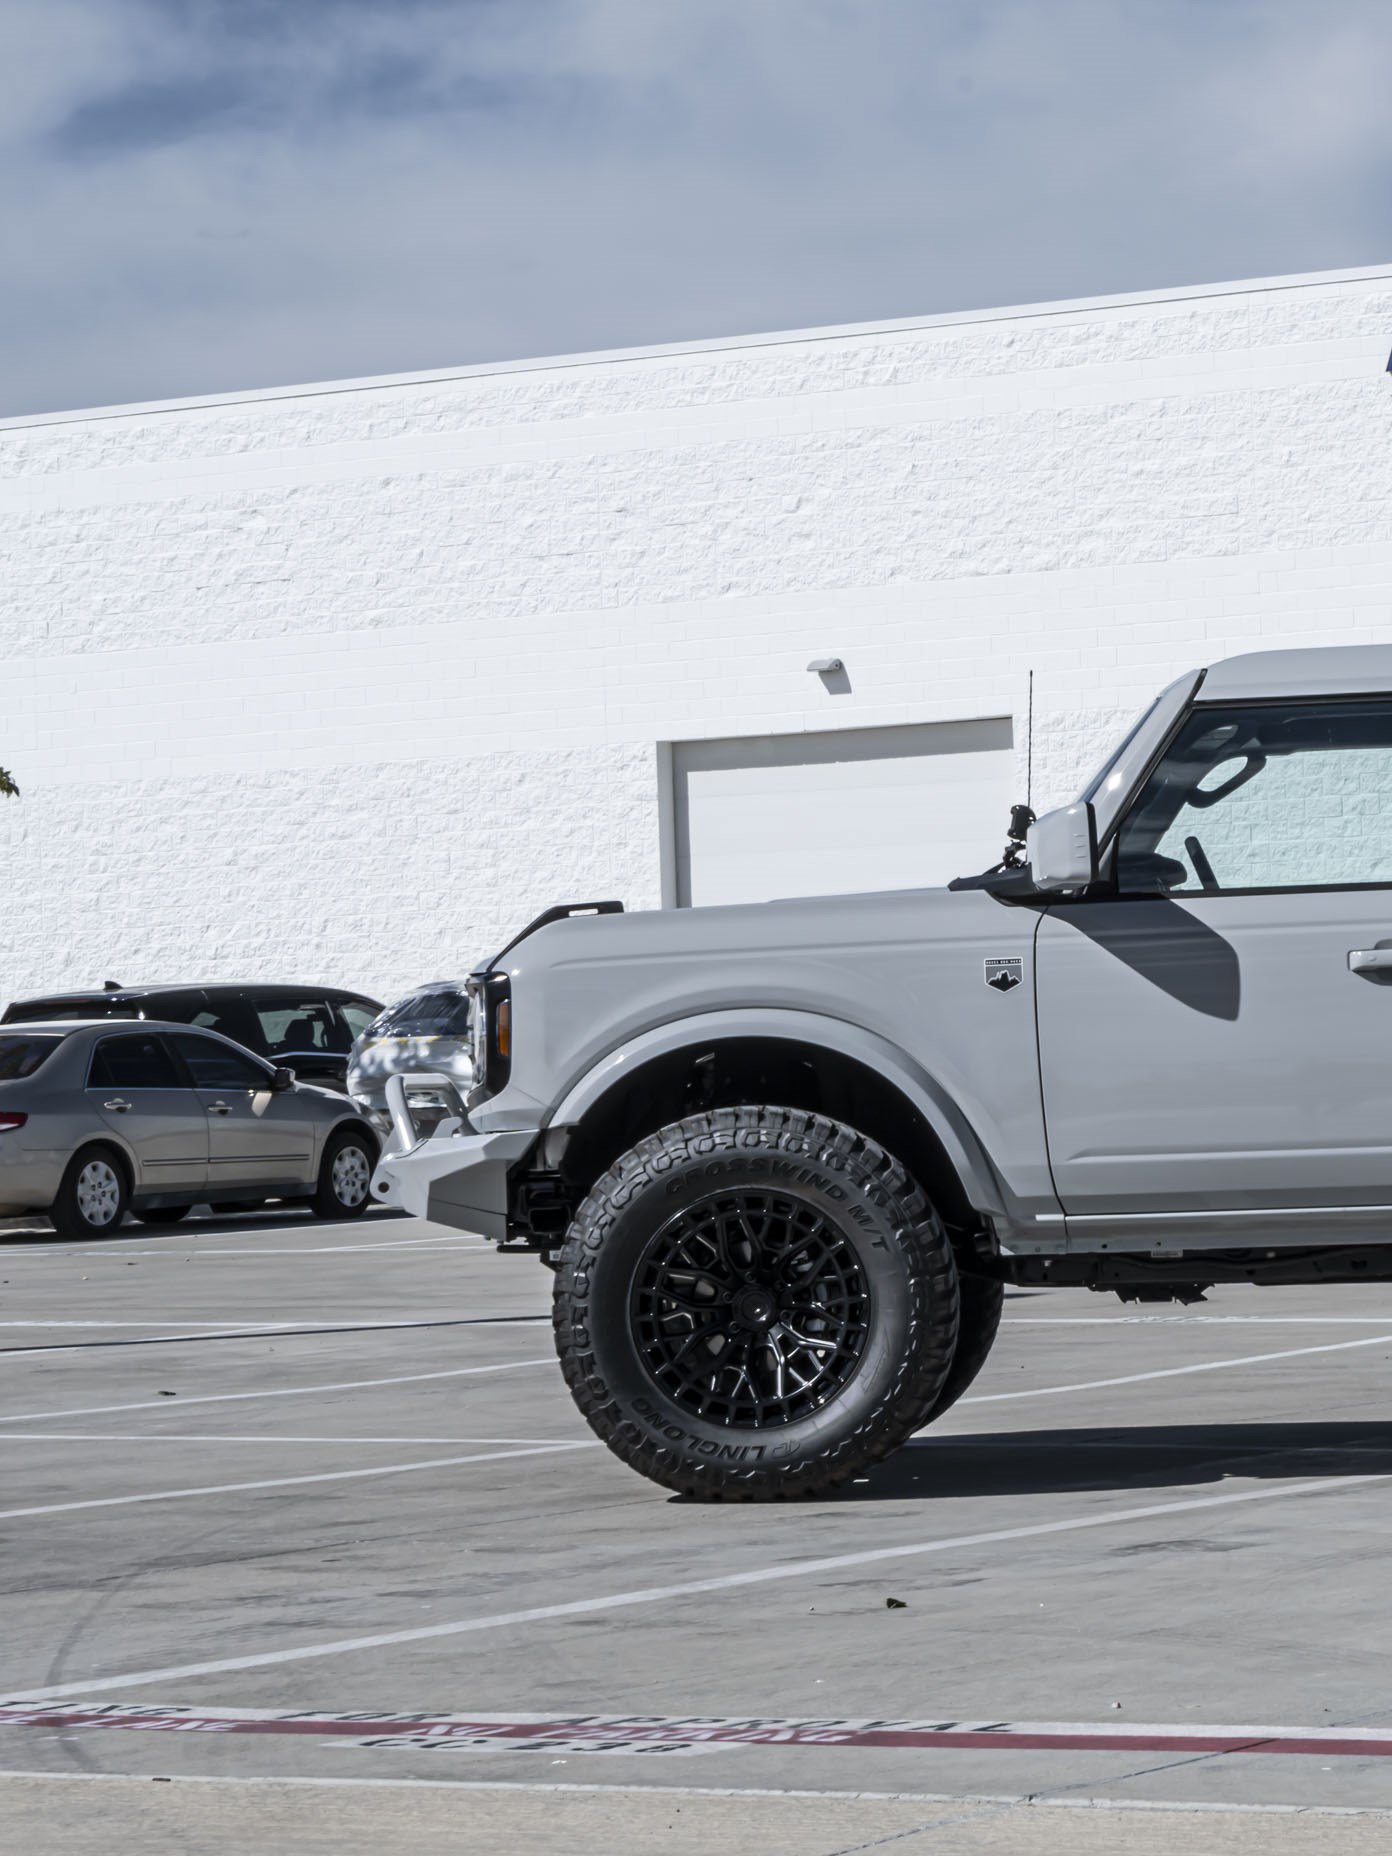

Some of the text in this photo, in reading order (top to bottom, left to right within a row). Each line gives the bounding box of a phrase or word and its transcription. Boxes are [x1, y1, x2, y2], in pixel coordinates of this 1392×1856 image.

[665, 1157, 890, 1251] CROSSWIND M/T
[631, 1397, 767, 1460] LINGLONG
[276, 1711, 452, 1723] FOR
[535, 1716, 1014, 1733] APPROVAL
[402, 1724, 515, 1736] NO
[357, 1737, 488, 1749] CC
